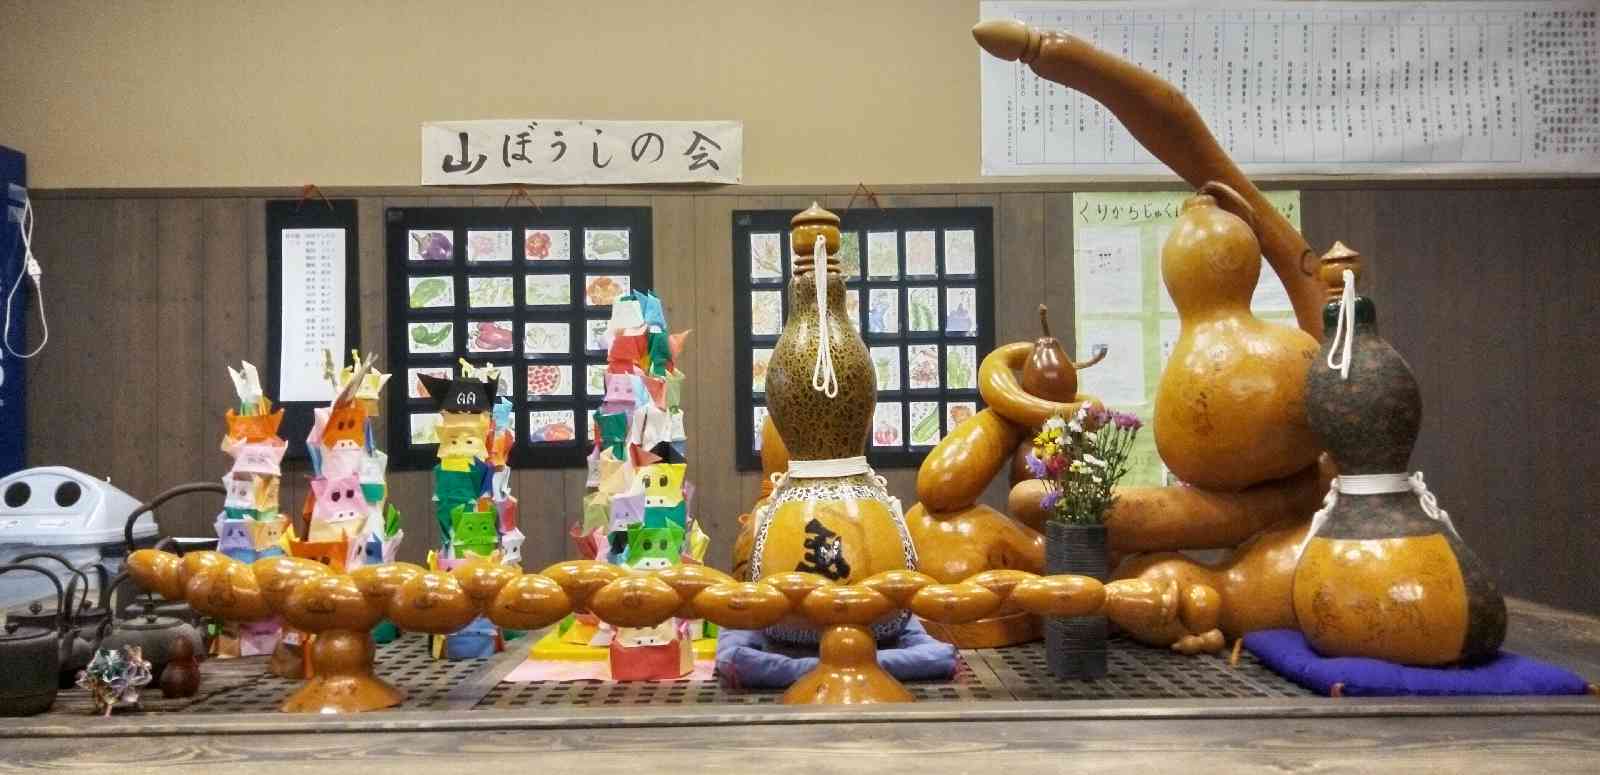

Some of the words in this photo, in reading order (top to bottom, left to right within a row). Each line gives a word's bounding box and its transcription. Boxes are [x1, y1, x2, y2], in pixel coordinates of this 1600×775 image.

[442, 122, 721, 174] 山ぼうしの会
[1080, 199, 1179, 222] くりからじゅく
